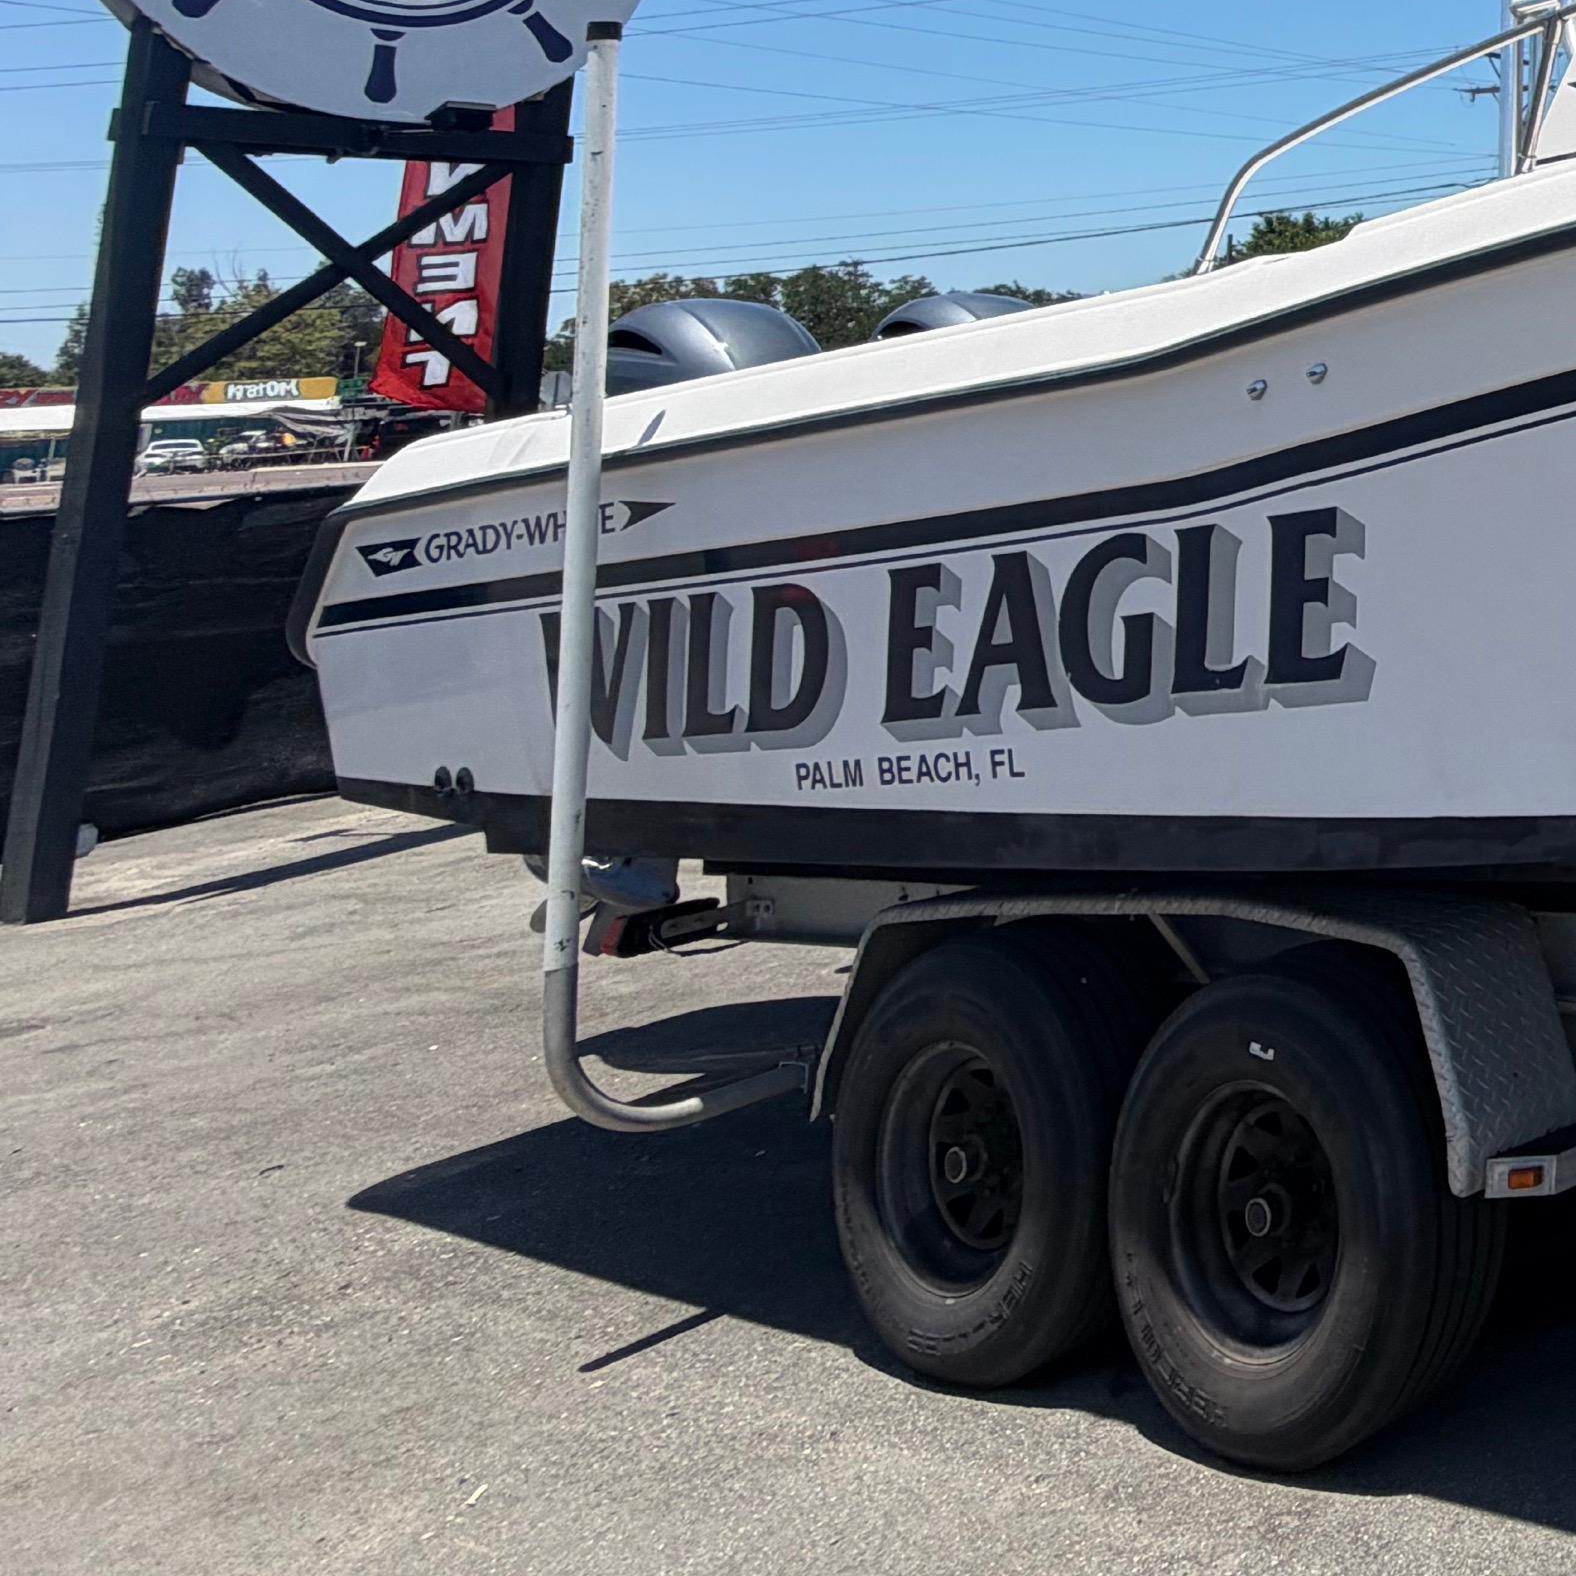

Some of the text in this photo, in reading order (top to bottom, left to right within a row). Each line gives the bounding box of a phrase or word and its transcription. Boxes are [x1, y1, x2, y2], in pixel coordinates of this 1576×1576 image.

[424, 501, 615, 564] GRADY-WHE
[539, 507, 1364, 754] WILD EAGLE
[795, 748, 1026, 791] PALM BEACH, FL
